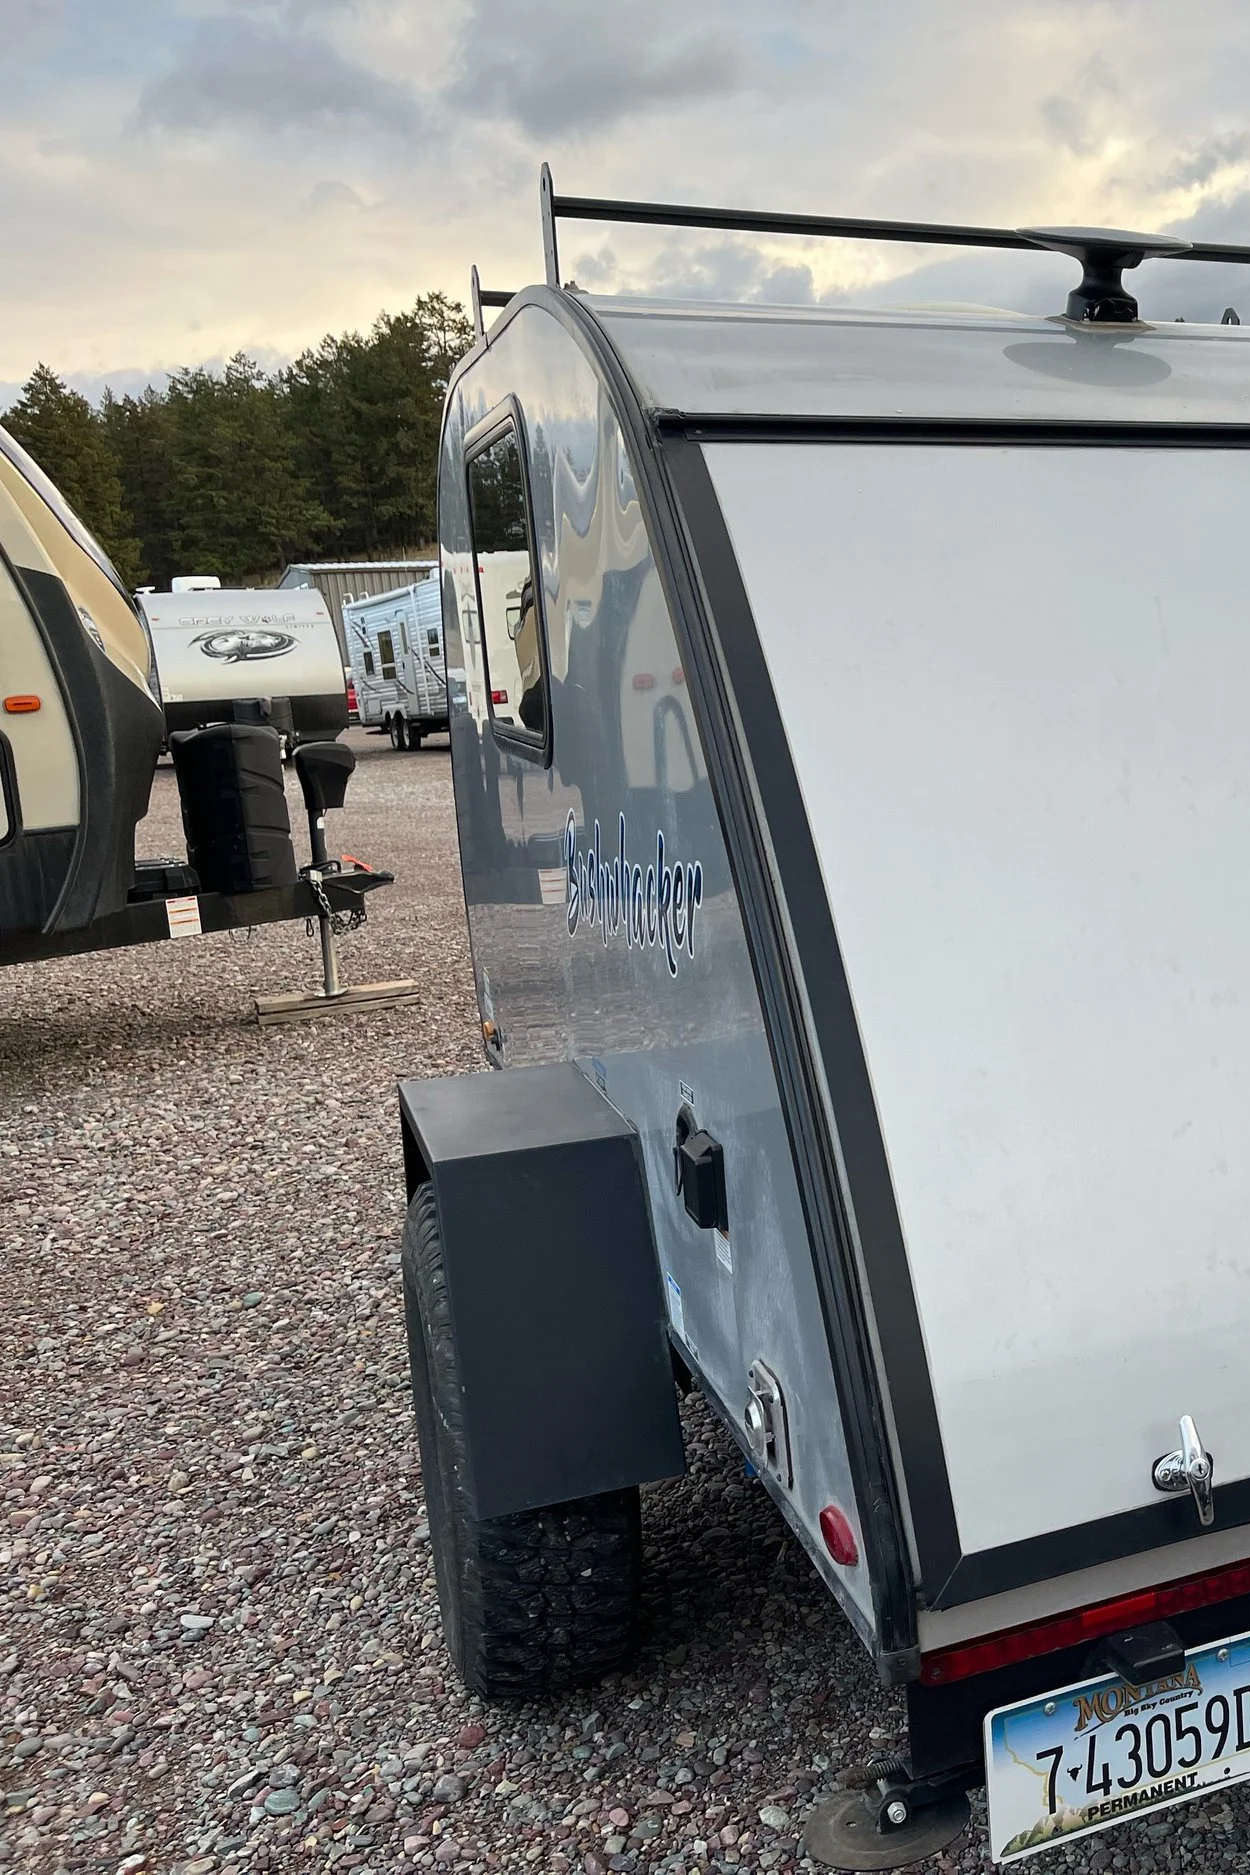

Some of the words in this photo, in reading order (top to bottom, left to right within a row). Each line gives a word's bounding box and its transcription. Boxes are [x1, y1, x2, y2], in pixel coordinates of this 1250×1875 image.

[179, 615, 234, 625] GREY
[563, 807, 703, 978] Bushwhacker
[1123, 1707, 1139, 1717] Big
[1140, 1701, 1157, 1712] Sky
[1159, 1690, 1194, 1706] Country
[1087, 1771, 1199, 1820] PERMANENT
